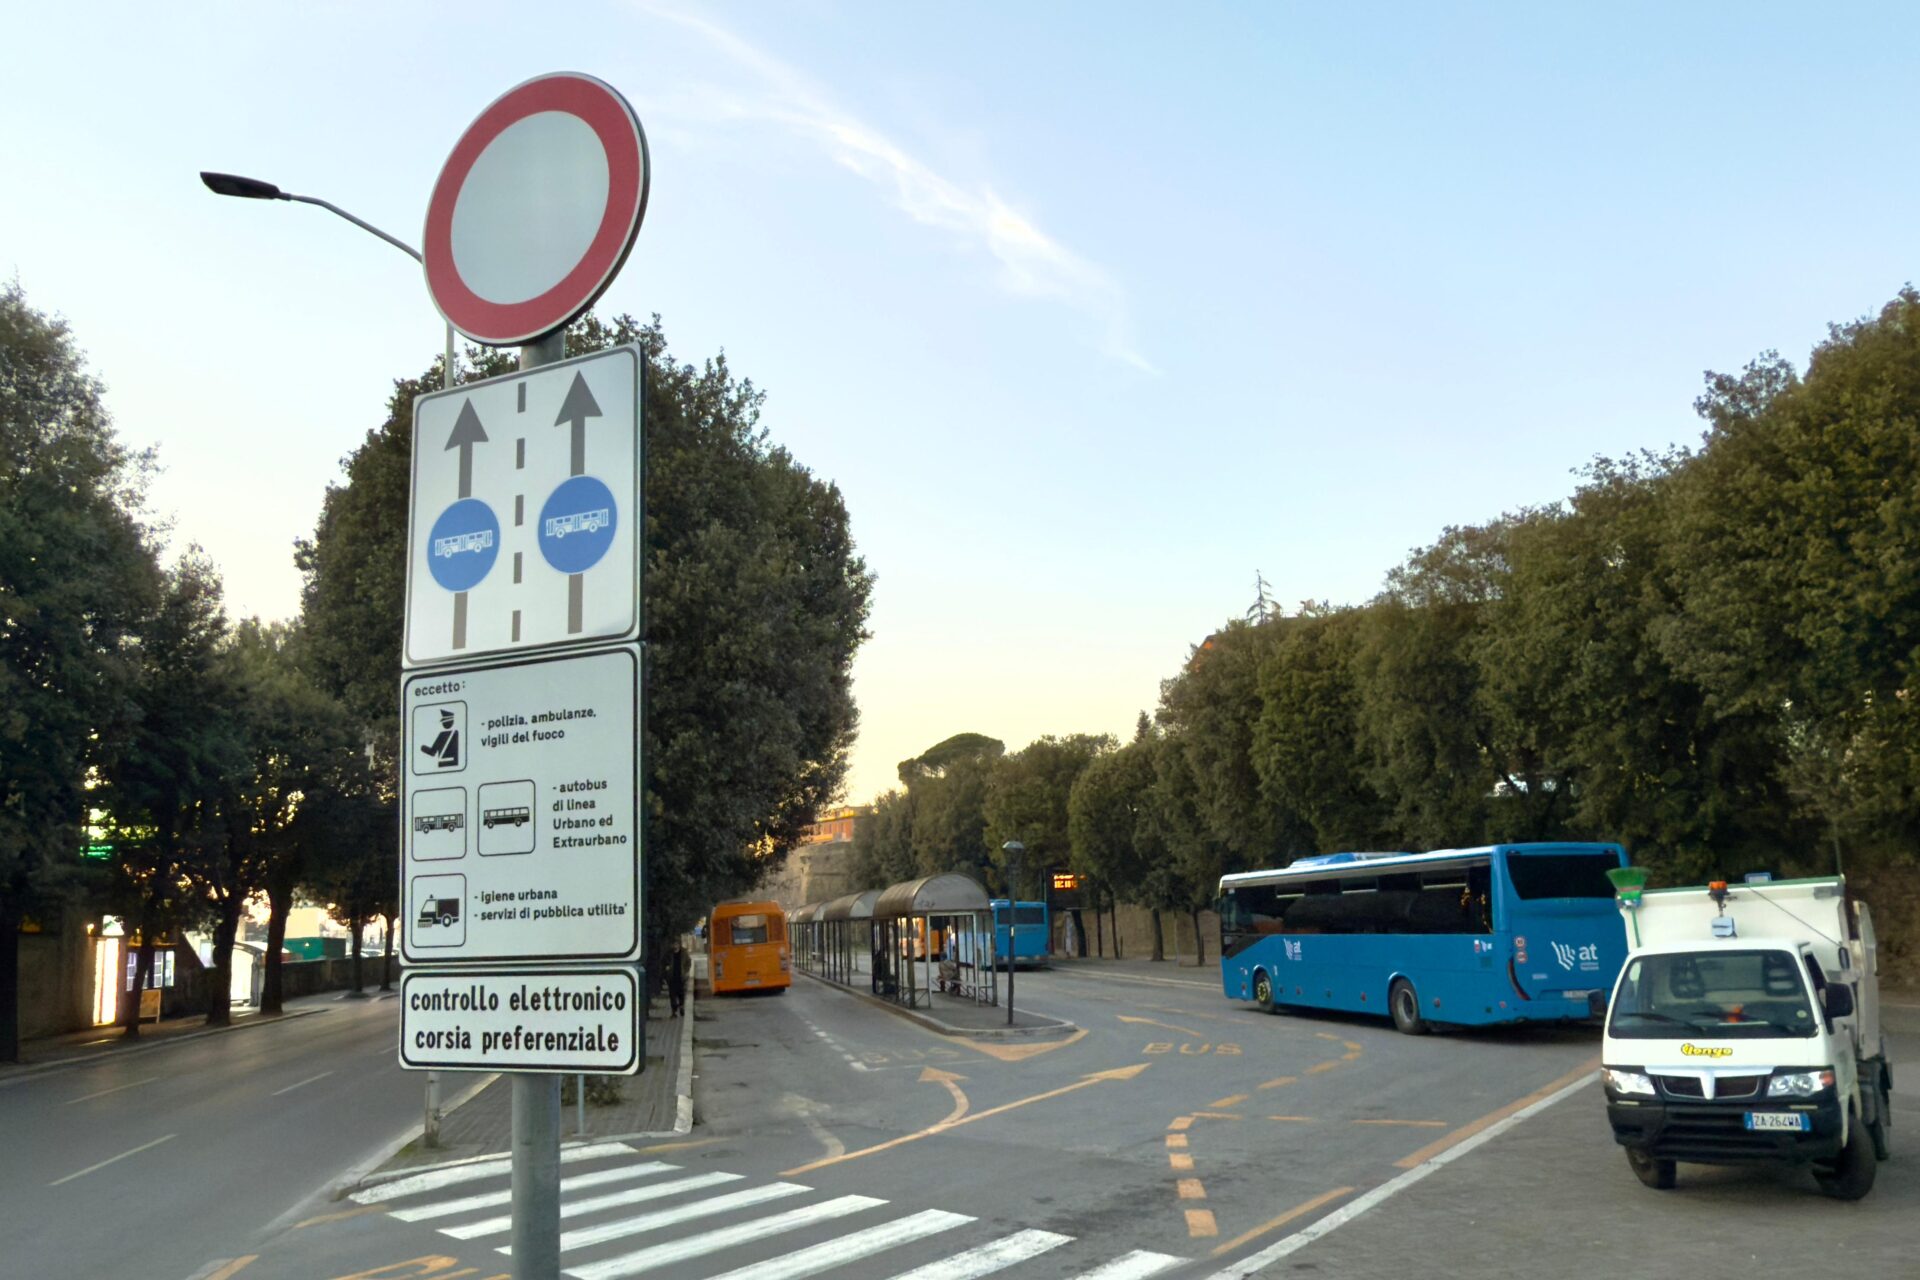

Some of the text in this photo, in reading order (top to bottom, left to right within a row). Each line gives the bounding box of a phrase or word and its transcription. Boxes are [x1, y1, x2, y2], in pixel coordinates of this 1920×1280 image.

[414, 680, 466, 697] eccetto:
[480, 729, 565, 748] vigili del fuoco
[559, 778, 608, 794] autobus
[552, 798, 597, 812] di linea
[552, 813, 614, 831] Urbano ed
[552, 833, 628, 849] Extraurbano
[480, 890, 515, 905] igiene
[517, 888, 558, 901] urbana
[480, 907, 517, 921] servizi
[519, 906, 531, 920] di
[533, 904, 585, 921] pubblica
[1578, 943, 1599, 960] at
[410, 984, 627, 1012] controllo elettronico
[415, 1023, 620, 1055] corsia preferenziale
[1142, 1042, 1243, 1057] BUS
